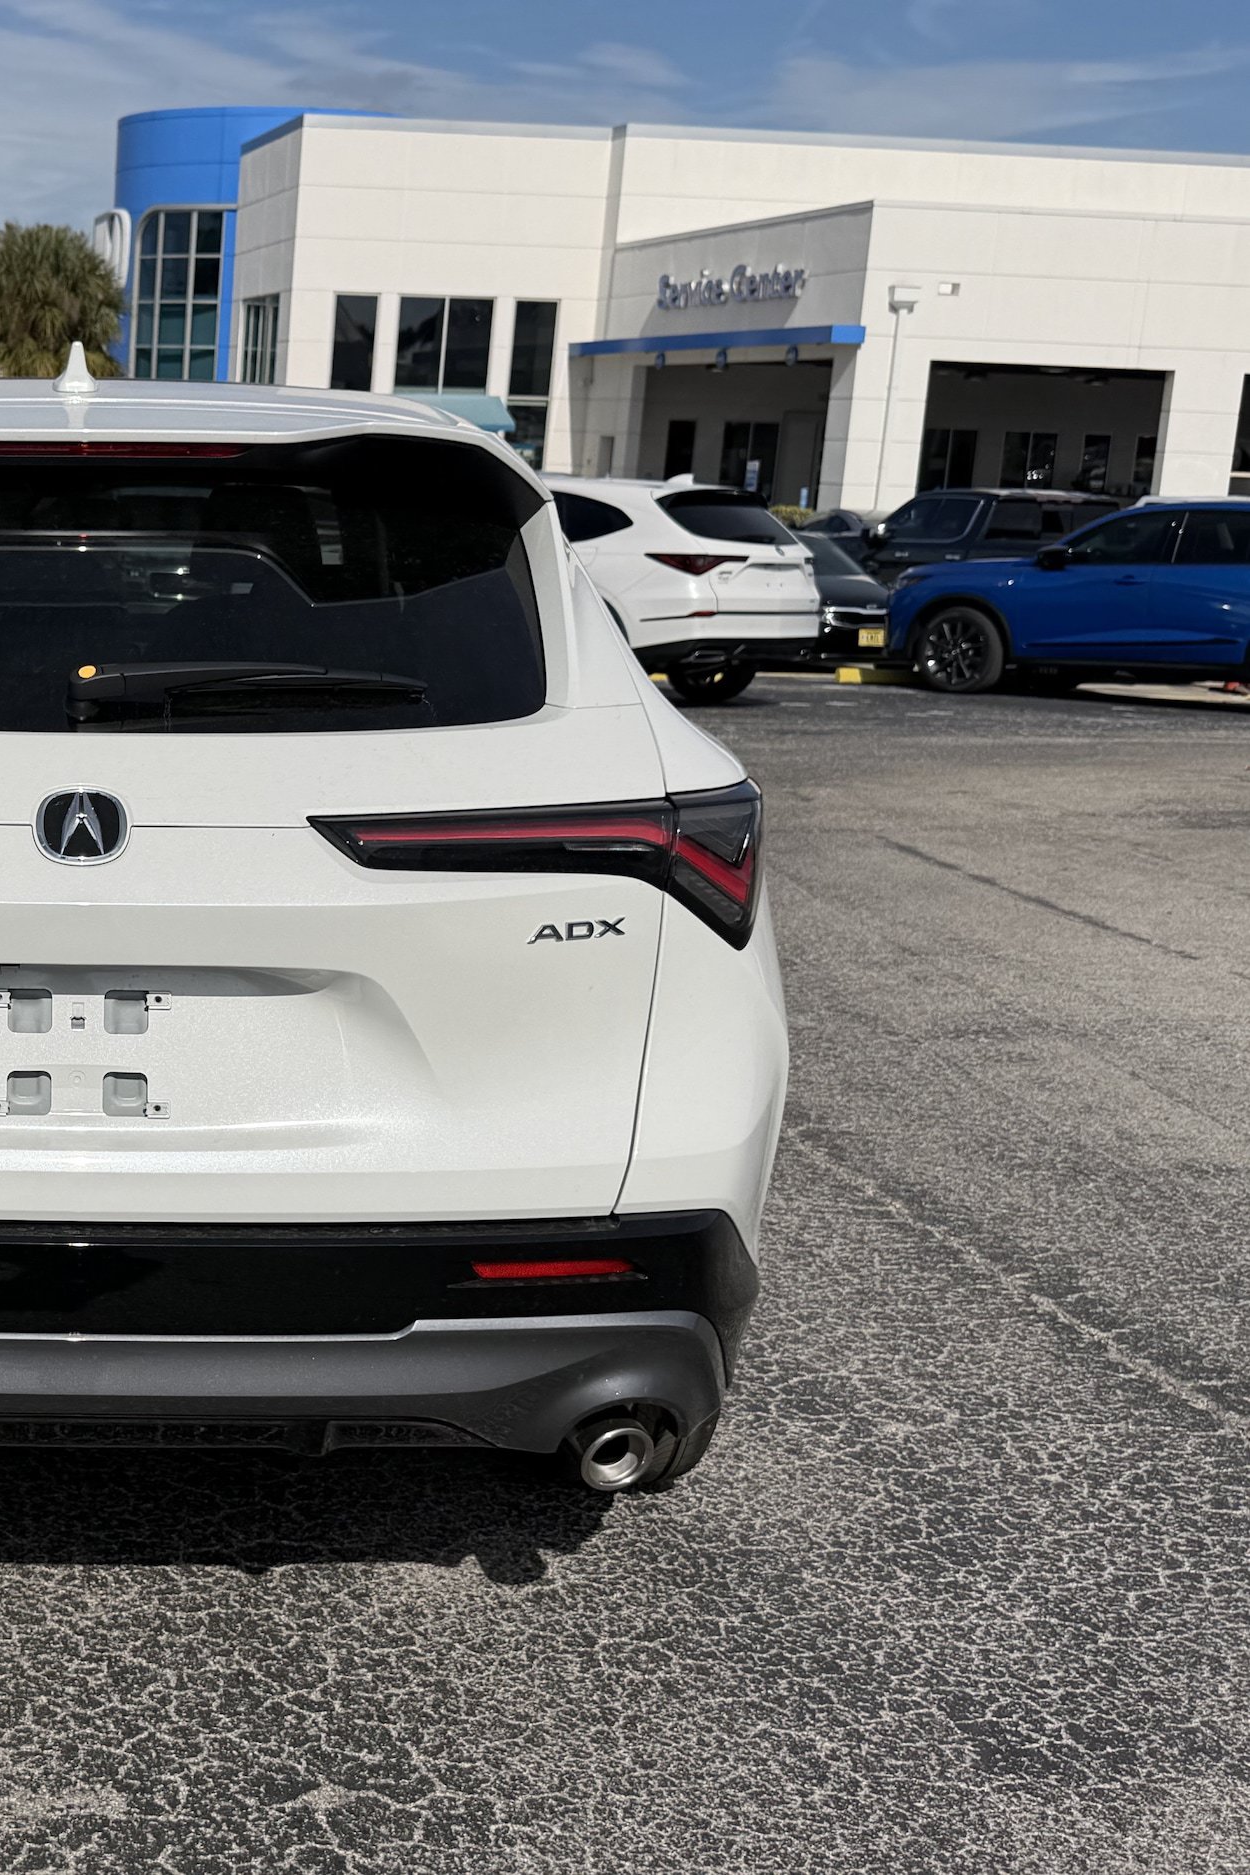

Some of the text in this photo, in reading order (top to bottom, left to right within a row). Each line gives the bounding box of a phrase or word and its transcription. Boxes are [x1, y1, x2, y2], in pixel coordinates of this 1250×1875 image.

[657, 264, 806, 309] Service Center
[527, 917, 625, 944] ADX
